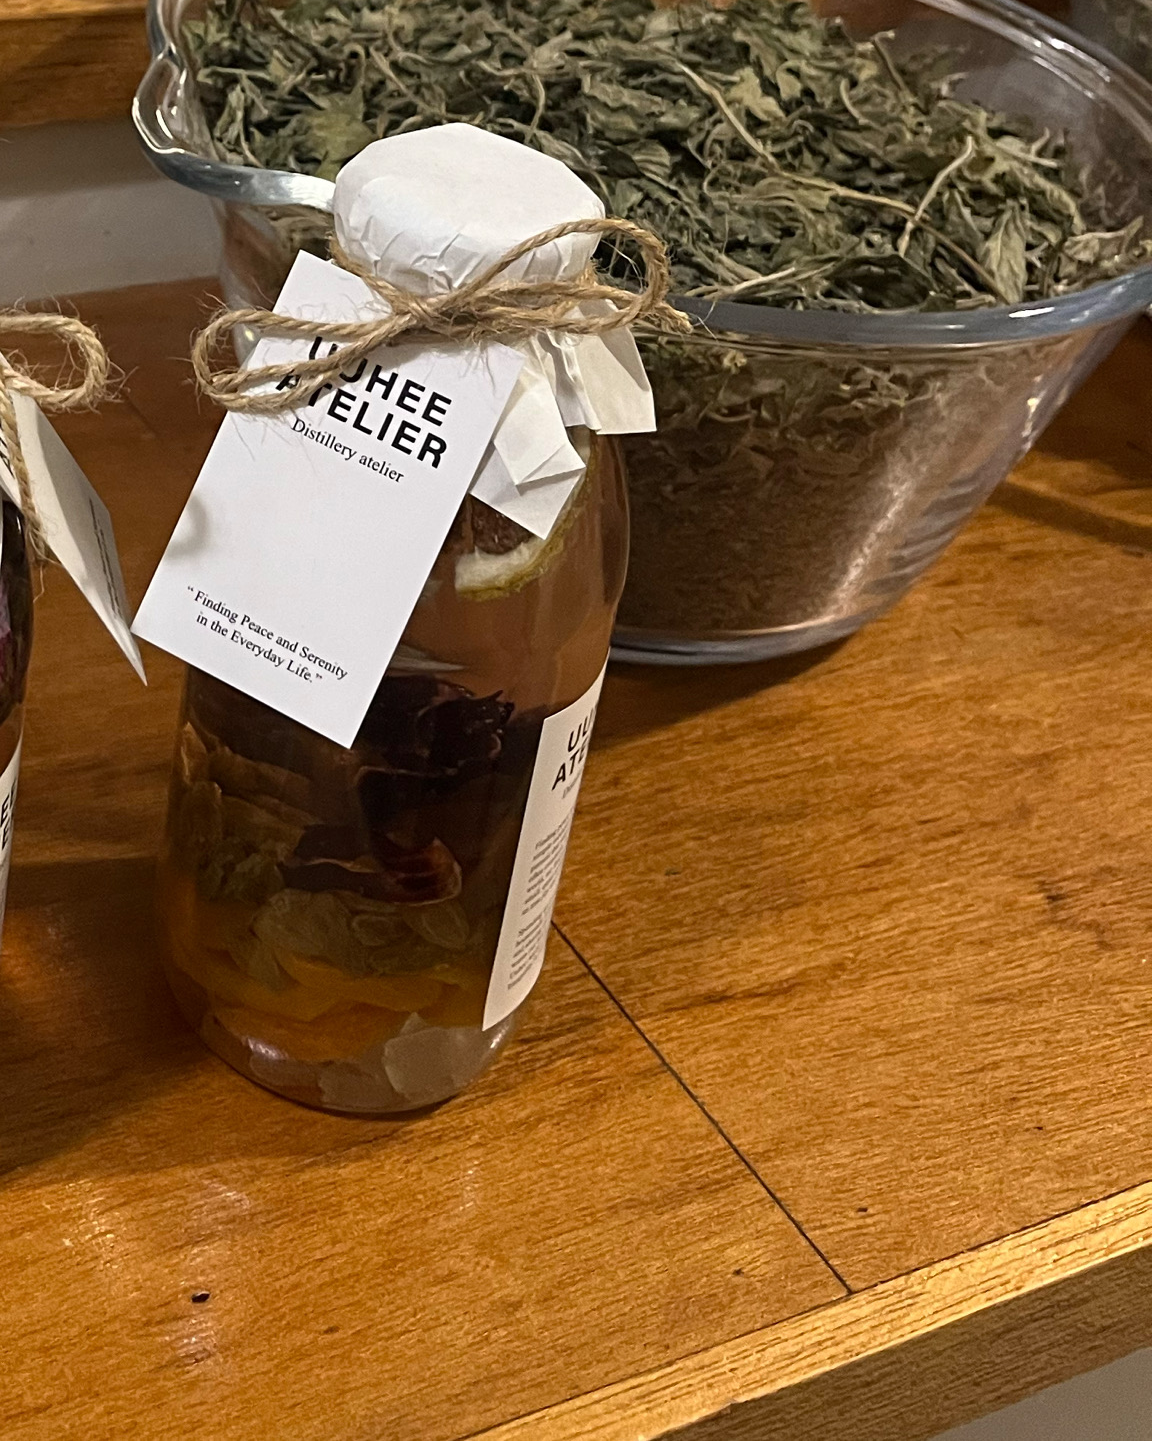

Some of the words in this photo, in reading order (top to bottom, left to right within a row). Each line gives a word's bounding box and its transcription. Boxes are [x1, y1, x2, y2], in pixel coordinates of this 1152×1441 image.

[291, 418, 357, 460] Distillery
[359, 454, 404, 483] atelier
[194, 590, 238, 624] Finding
[241, 614, 274, 640] Peace
[276, 635, 299, 653] and
[299, 646, 348, 680] Serenity
[196, 611, 208, 626] in
[210, 620, 228, 636] the
[230, 630, 284, 668] Everyday
